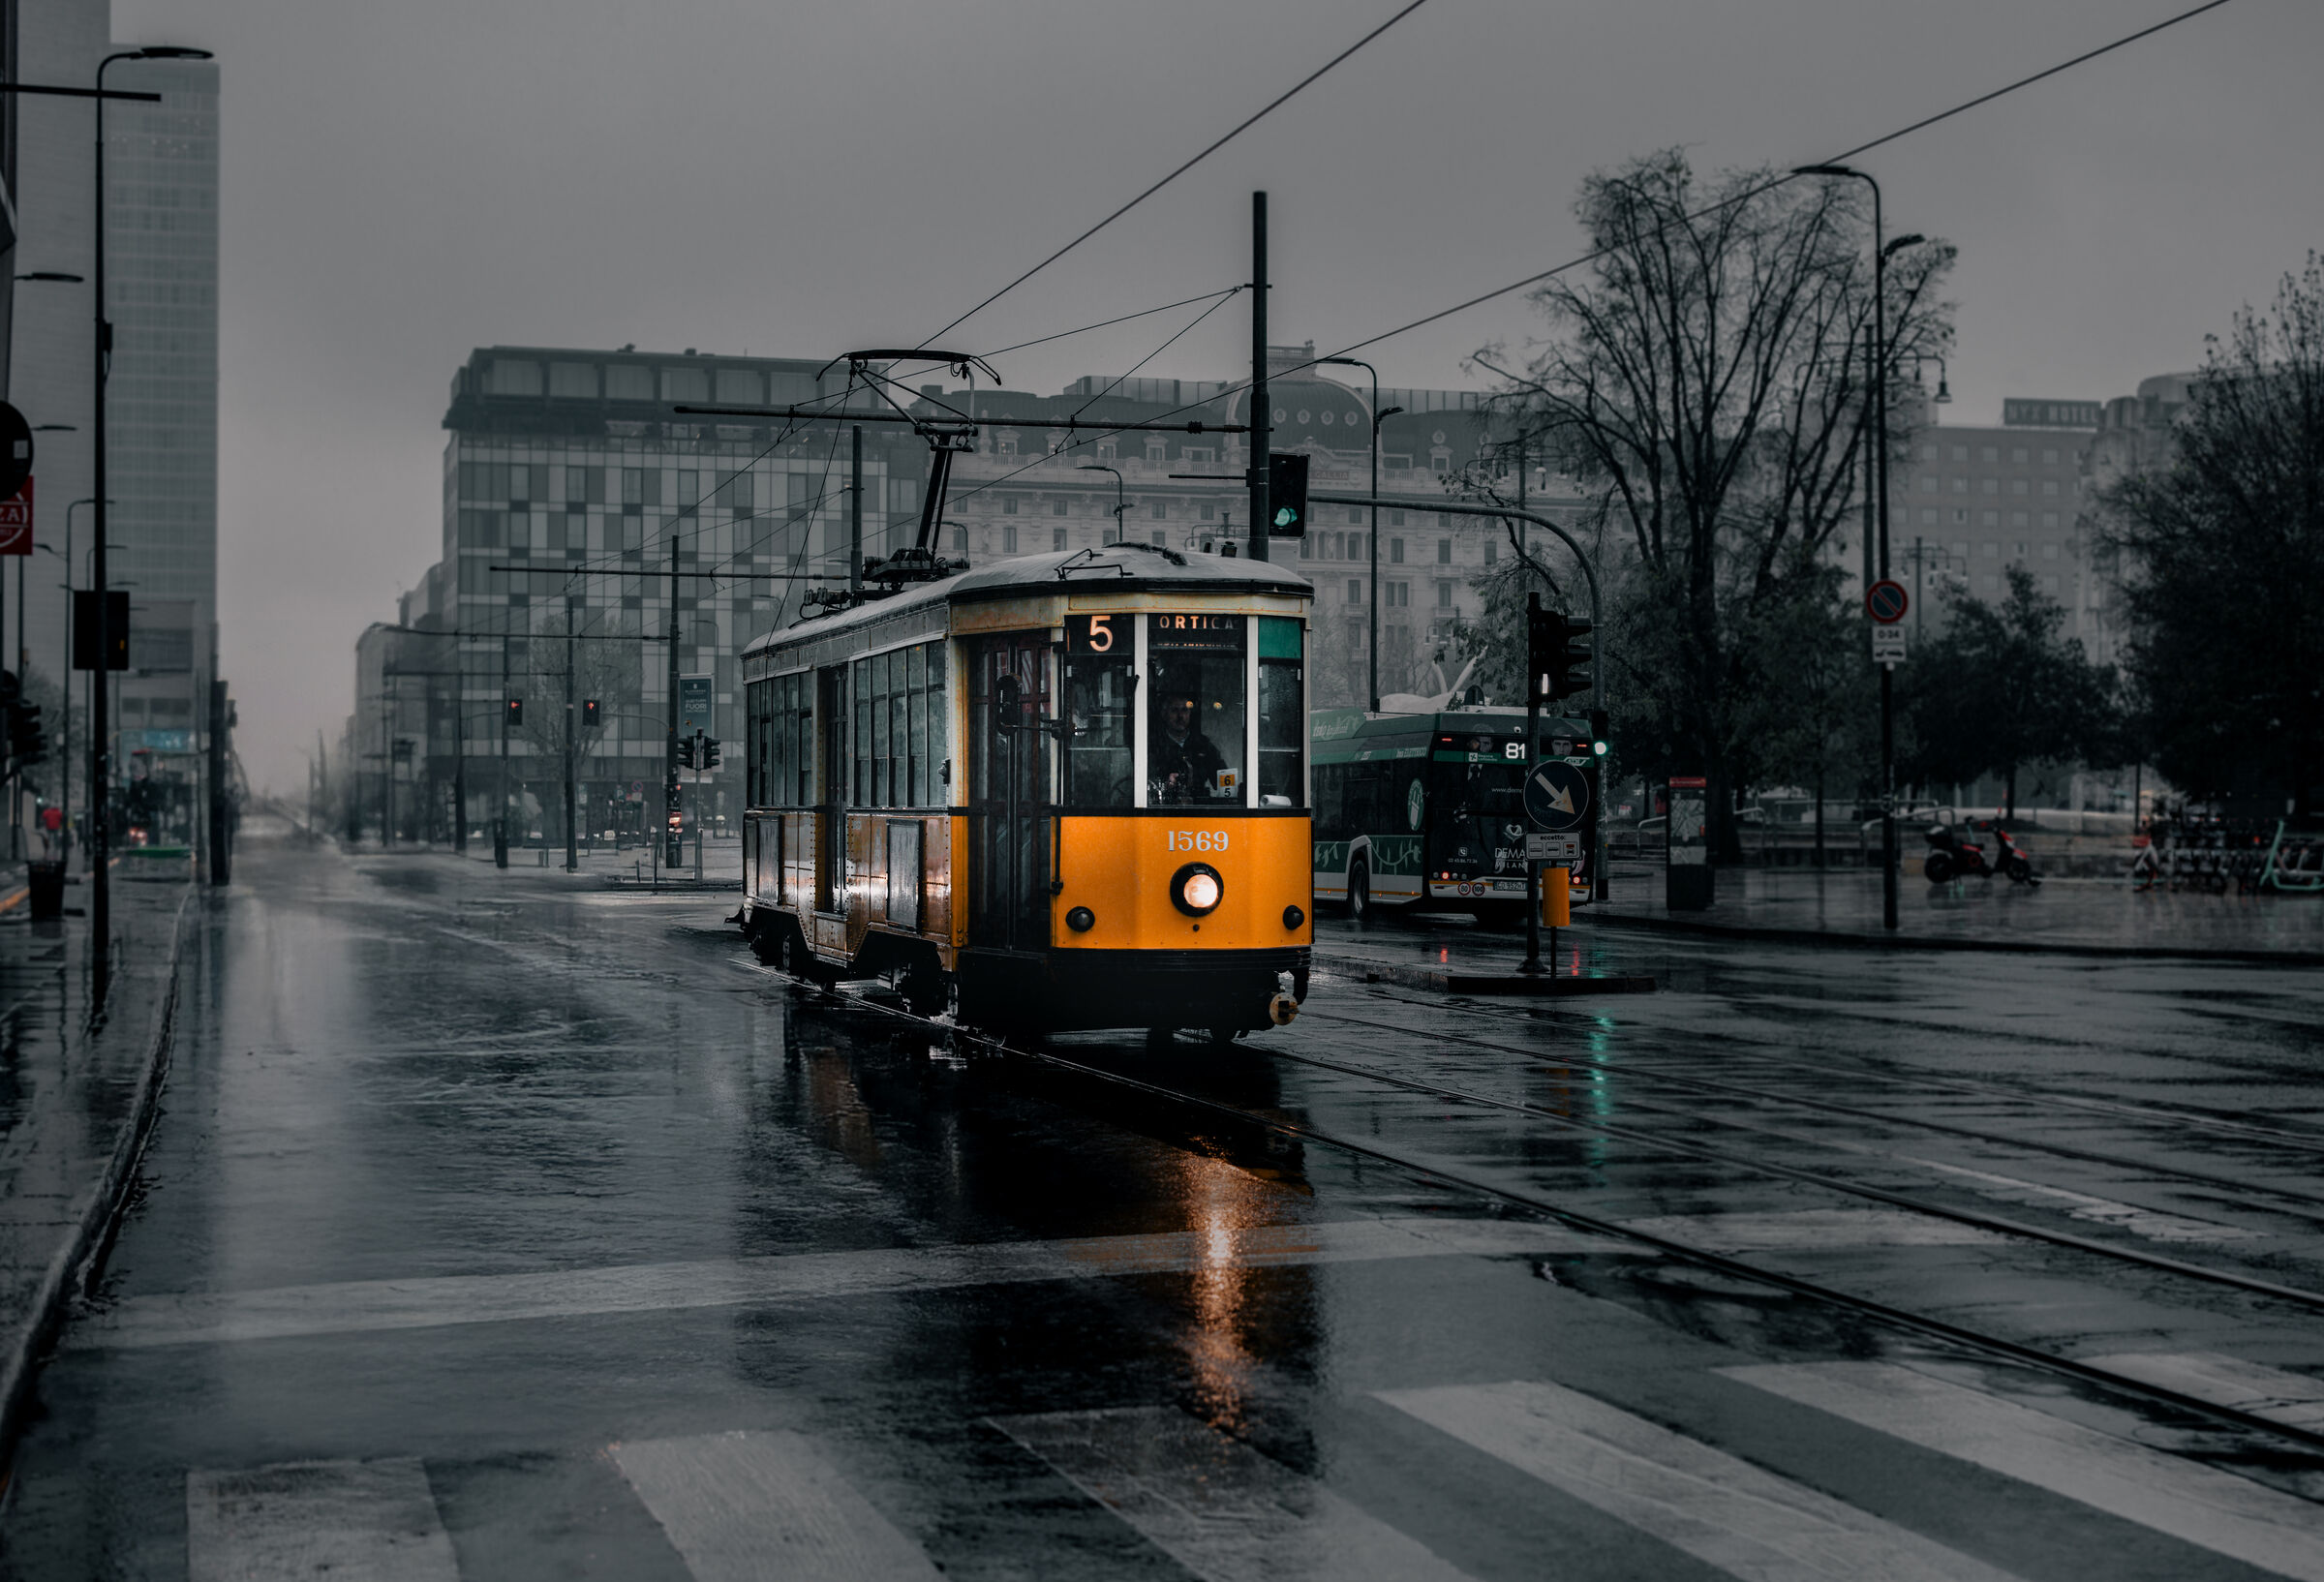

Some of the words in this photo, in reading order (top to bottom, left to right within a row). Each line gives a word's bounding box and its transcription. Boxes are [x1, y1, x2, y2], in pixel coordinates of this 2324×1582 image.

[2048, 405, 2098, 423] HOTEL
[1159, 615, 1235, 629] ORTICA
[1089, 615, 1114, 653] 5
[1505, 742, 1527, 759] 81
[1224, 776, 1232, 786] 6
[1224, 787, 1232, 798] 5
[1168, 830, 1229, 852] 1569
[1494, 847, 1526, 859] DEMA
